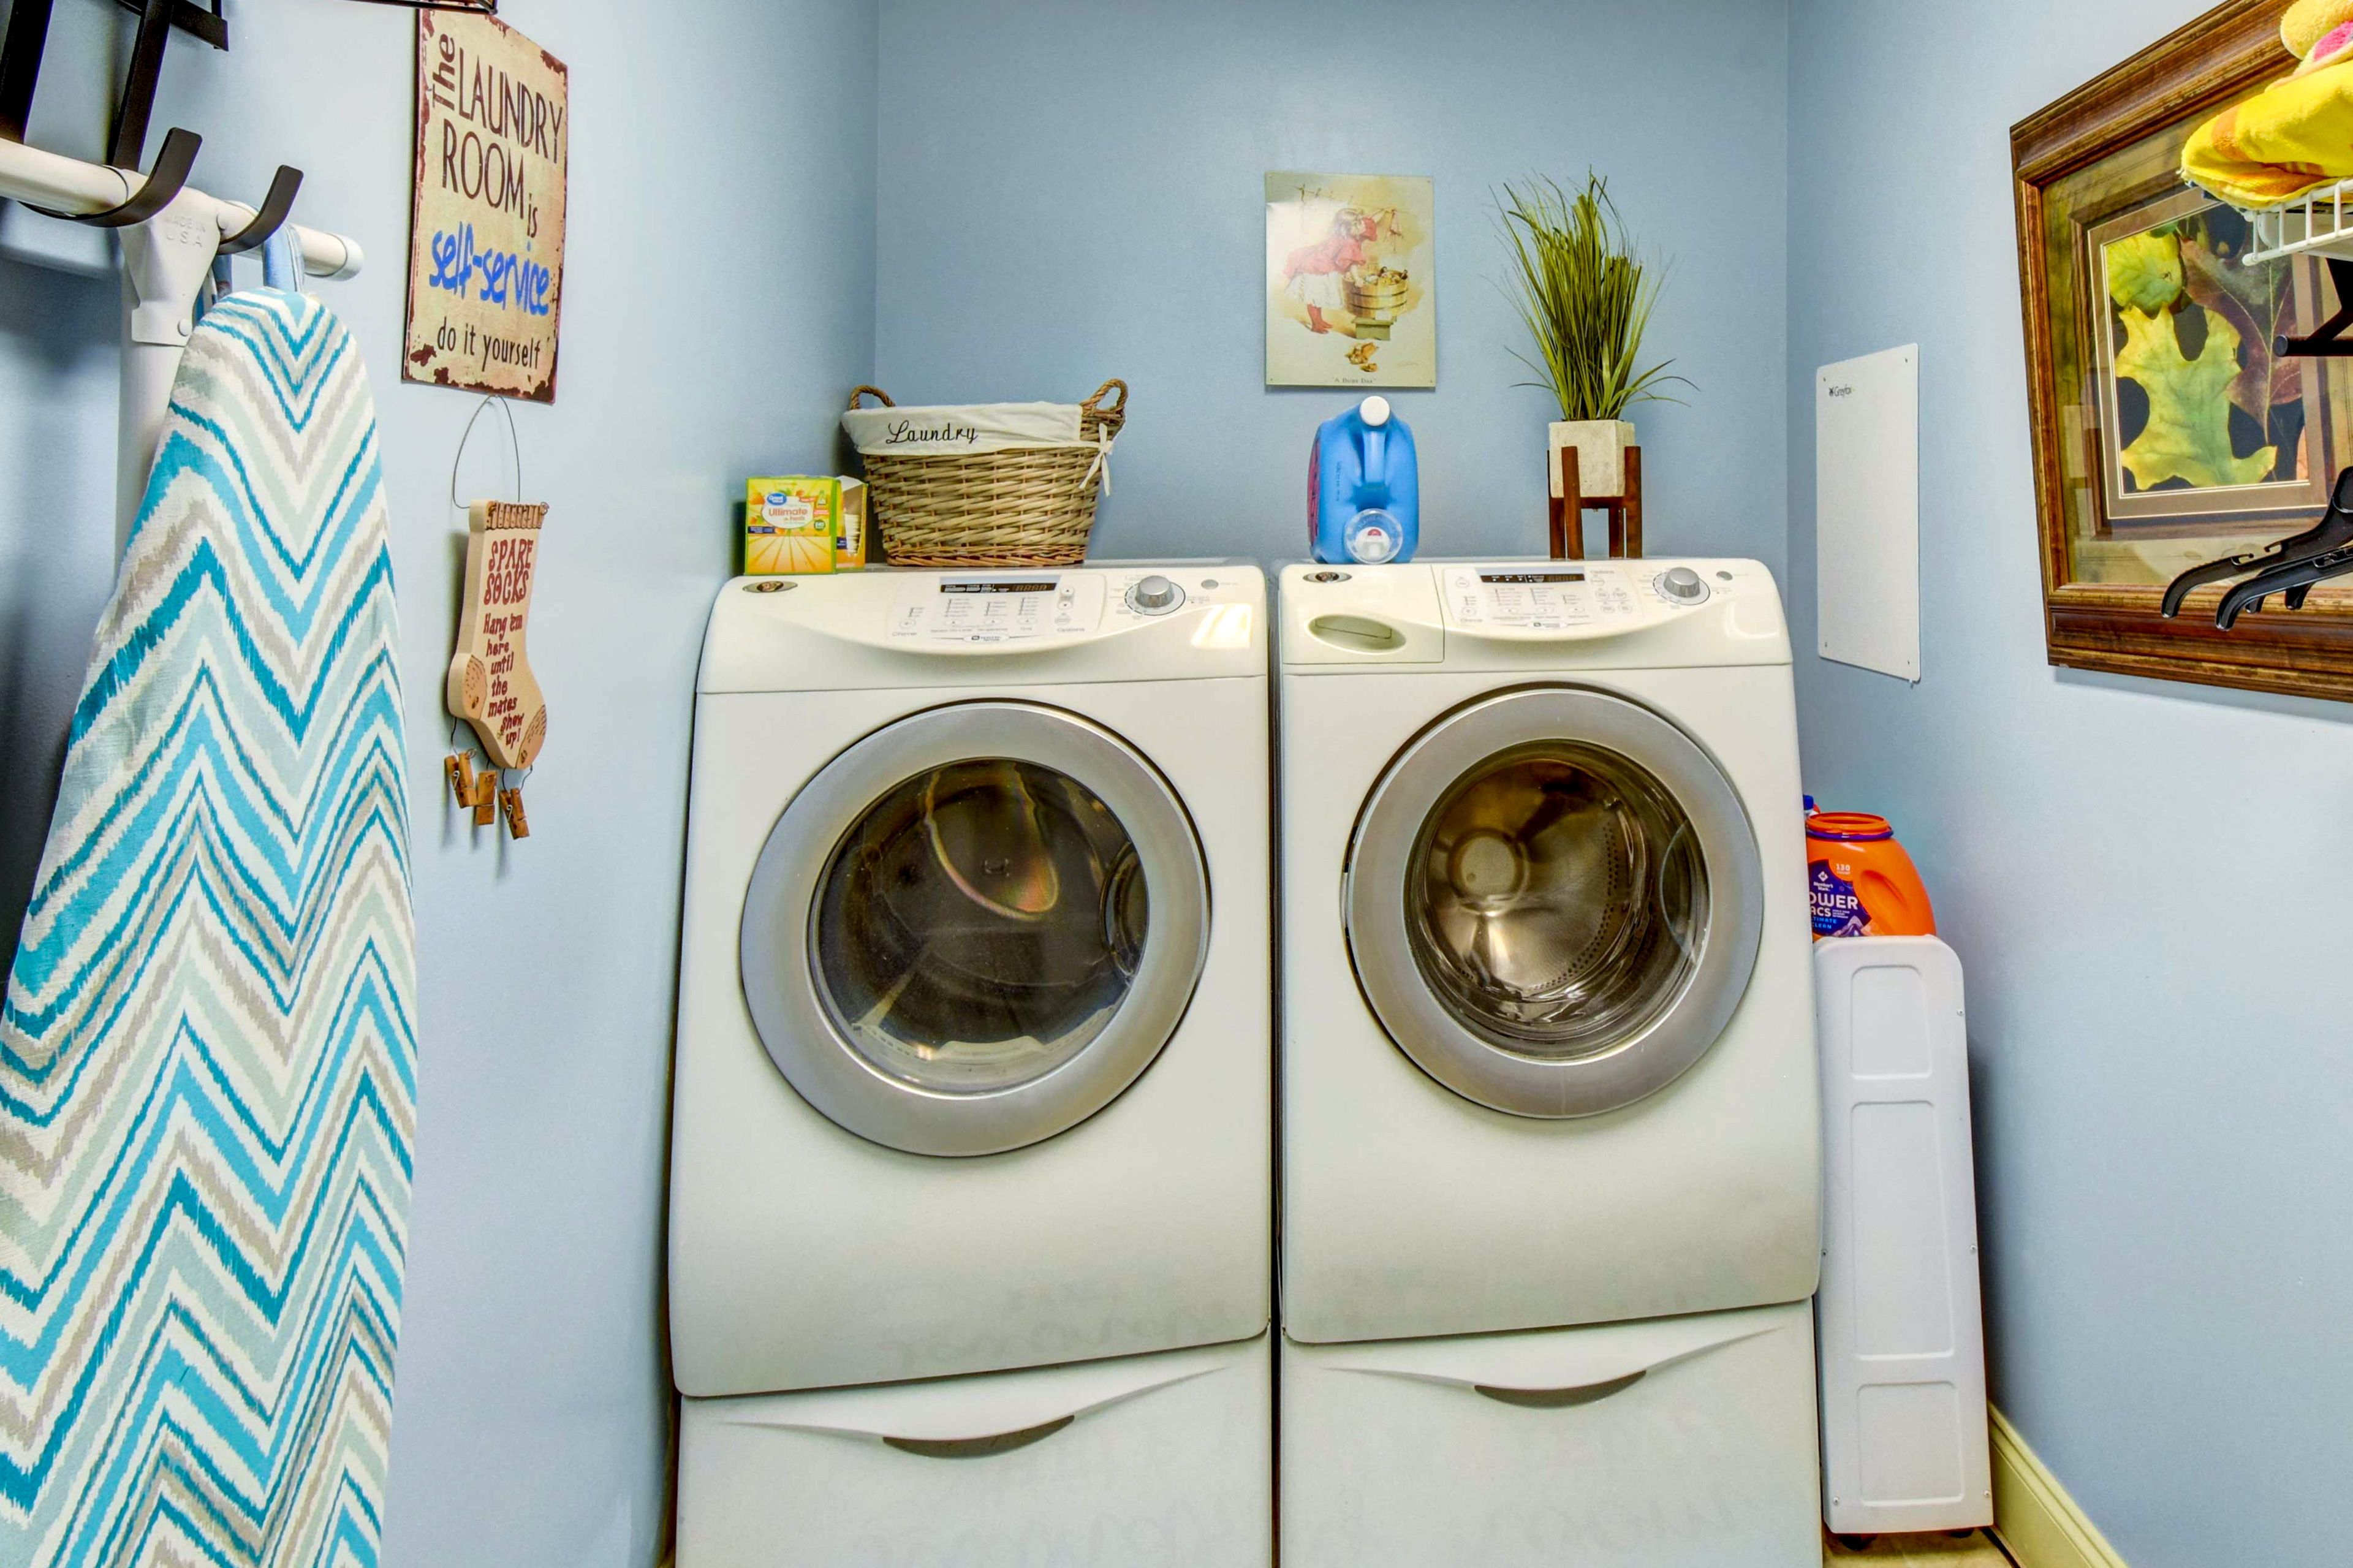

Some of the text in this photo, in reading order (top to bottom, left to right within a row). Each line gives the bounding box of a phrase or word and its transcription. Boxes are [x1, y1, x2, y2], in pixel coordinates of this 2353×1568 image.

[432, 32, 456, 112] The
[458, 47, 563, 164] LAUNDRY
[442, 118, 539, 239] ROOM is
[429, 221, 550, 317] self-service
[438, 316, 541, 373] do it yourself
[885, 420, 979, 444] Laundry
[768, 508, 808, 517] Ultimate
[488, 538, 534, 572] SPARE
[483, 569, 529, 606] SOCKS
[483, 613, 508, 642] Hang
[486, 638, 510, 657] here
[491, 651, 514, 675] until
[491, 675, 508, 697] the
[487, 697, 518, 718] mates
[500, 713, 525, 732] show
[506, 727, 521, 749] up!
[1809, 891, 1859, 911] OWER
[1810, 906, 1832, 918] ACS
